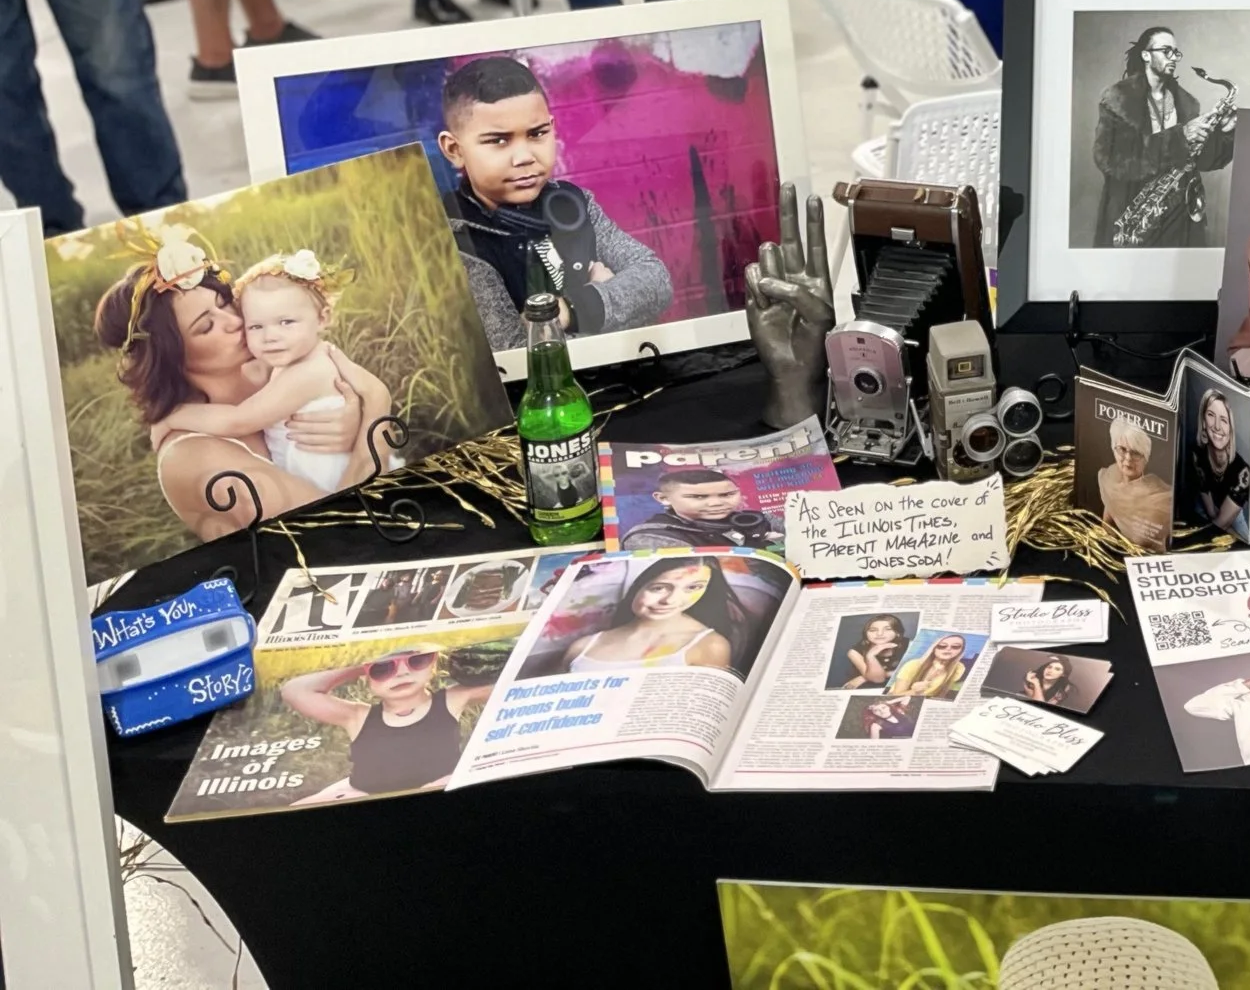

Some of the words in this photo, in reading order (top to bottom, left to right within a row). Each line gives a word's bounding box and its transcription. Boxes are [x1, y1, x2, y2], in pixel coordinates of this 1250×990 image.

[1098, 403, 1165, 436] PORTRAIT
[527, 431, 592, 459] JONES
[625, 426, 813, 468] parent
[799, 498, 820, 523] As
[899, 496, 925, 510] the
[931, 496, 968, 508] cover
[975, 490, 990, 506] of
[801, 525, 828, 539] the
[809, 540, 878, 558] PARENT
[971, 525, 993, 541] and
[1131, 560, 1175, 575] THE
[1136, 571, 1216, 588] STUDIO
[1140, 582, 1250, 602] HEADSHOT
[998, 607, 1050, 622] Studio
[1051, 603, 1094, 620] Bliss
[503, 678, 601, 702] Photoshoots
[602, 676, 630, 690] for
[496, 699, 554, 722] tweens
[555, 694, 595, 711] build
[484, 712, 604, 743] self-confidence
[996, 705, 1045, 729] Studio
[1041, 722, 1085, 746] Bliss
[210, 736, 322, 760] Images
[242, 756, 278, 775] of
[196, 771, 304, 797] Illinois
